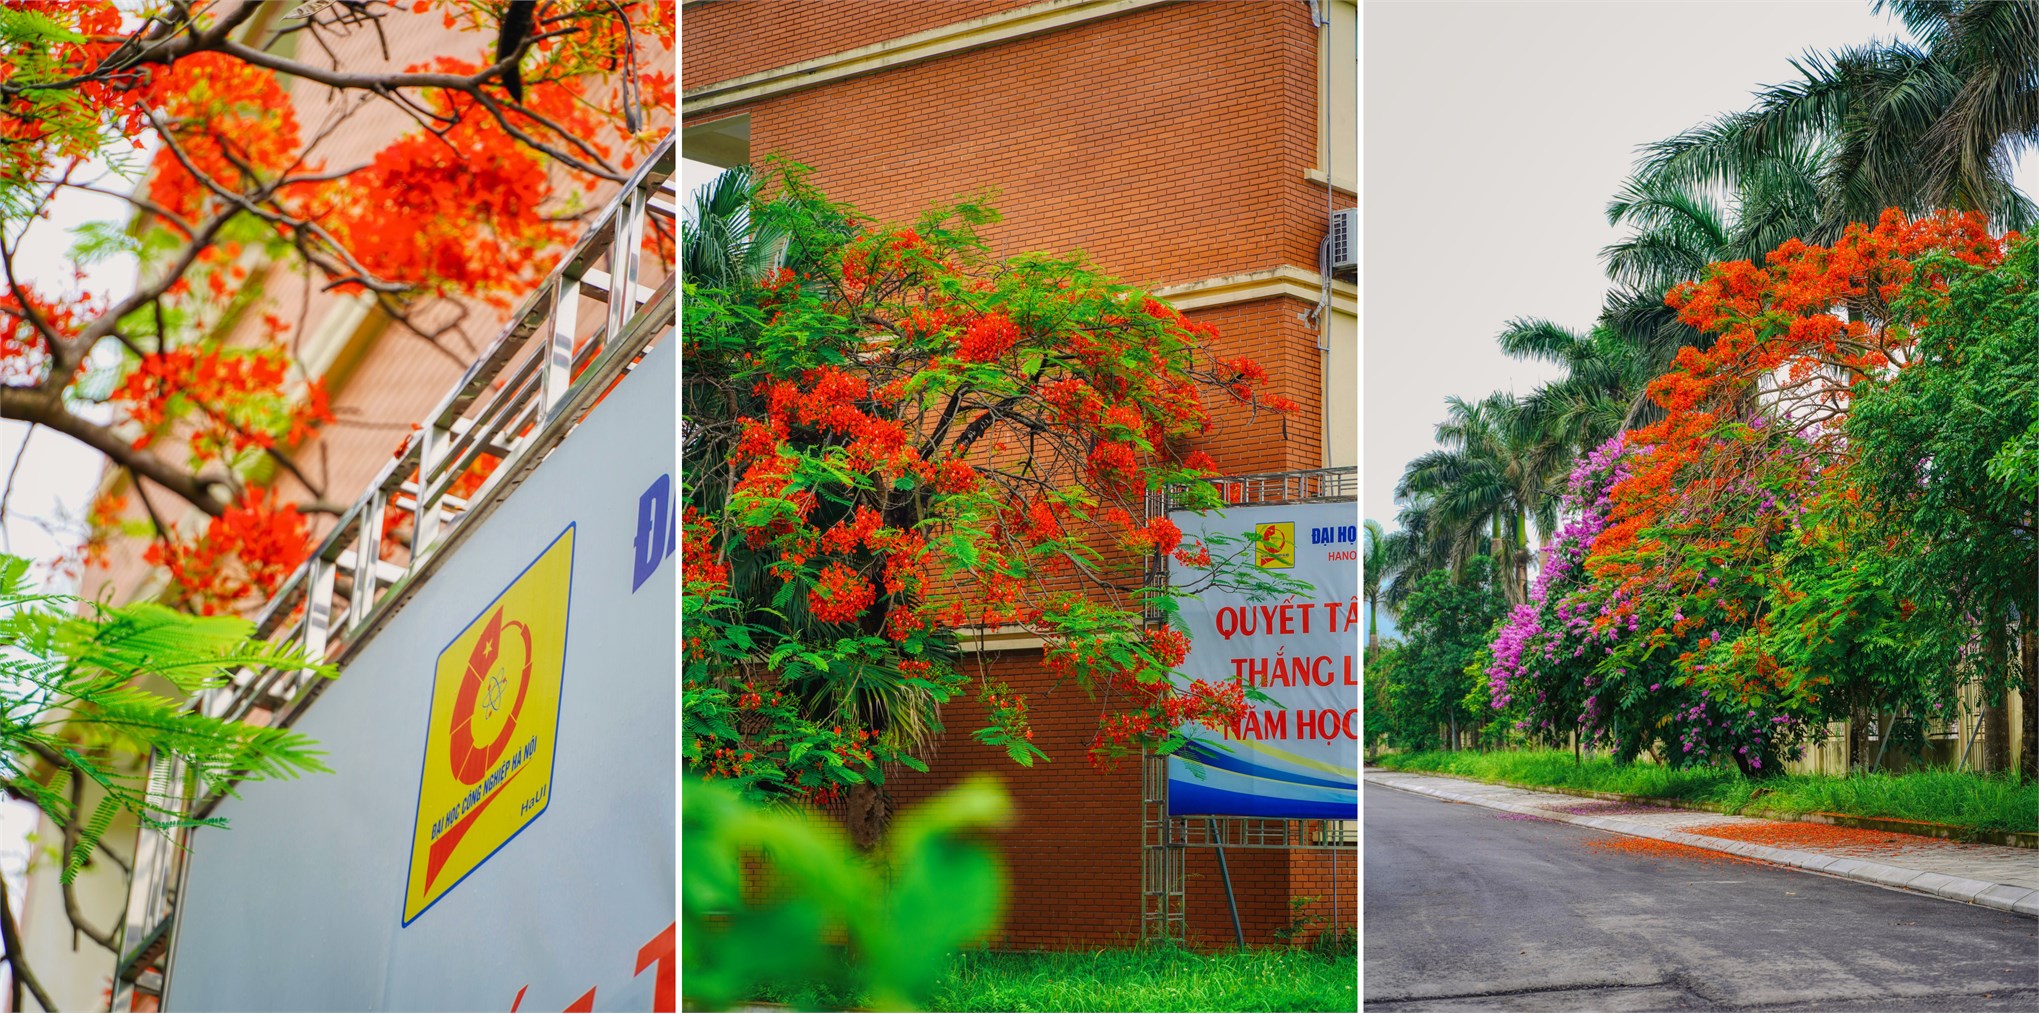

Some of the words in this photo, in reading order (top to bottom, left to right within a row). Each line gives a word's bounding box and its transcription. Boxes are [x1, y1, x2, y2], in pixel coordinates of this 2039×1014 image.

[632, 473, 675, 594] Đ
[1311, 526, 1334, 546] ĐẠI
[1338, 525, 1357, 545] HỌ
[1328, 550, 1357, 562] HANO
[1215, 594, 1315, 640] QUYẾT
[1231, 645, 1335, 688] THẮNG
[1296, 708, 1358, 746] HỌC
[431, 816, 445, 840] ĐẠI
[445, 803, 461, 828] HỌC
[461, 784, 482, 814] CÔNG
[483, 759, 511, 796] NGHIỆP
[512, 746, 522, 772] HÀ
[523, 735, 538, 760] NỘI
[520, 784, 547, 816] HaUI
